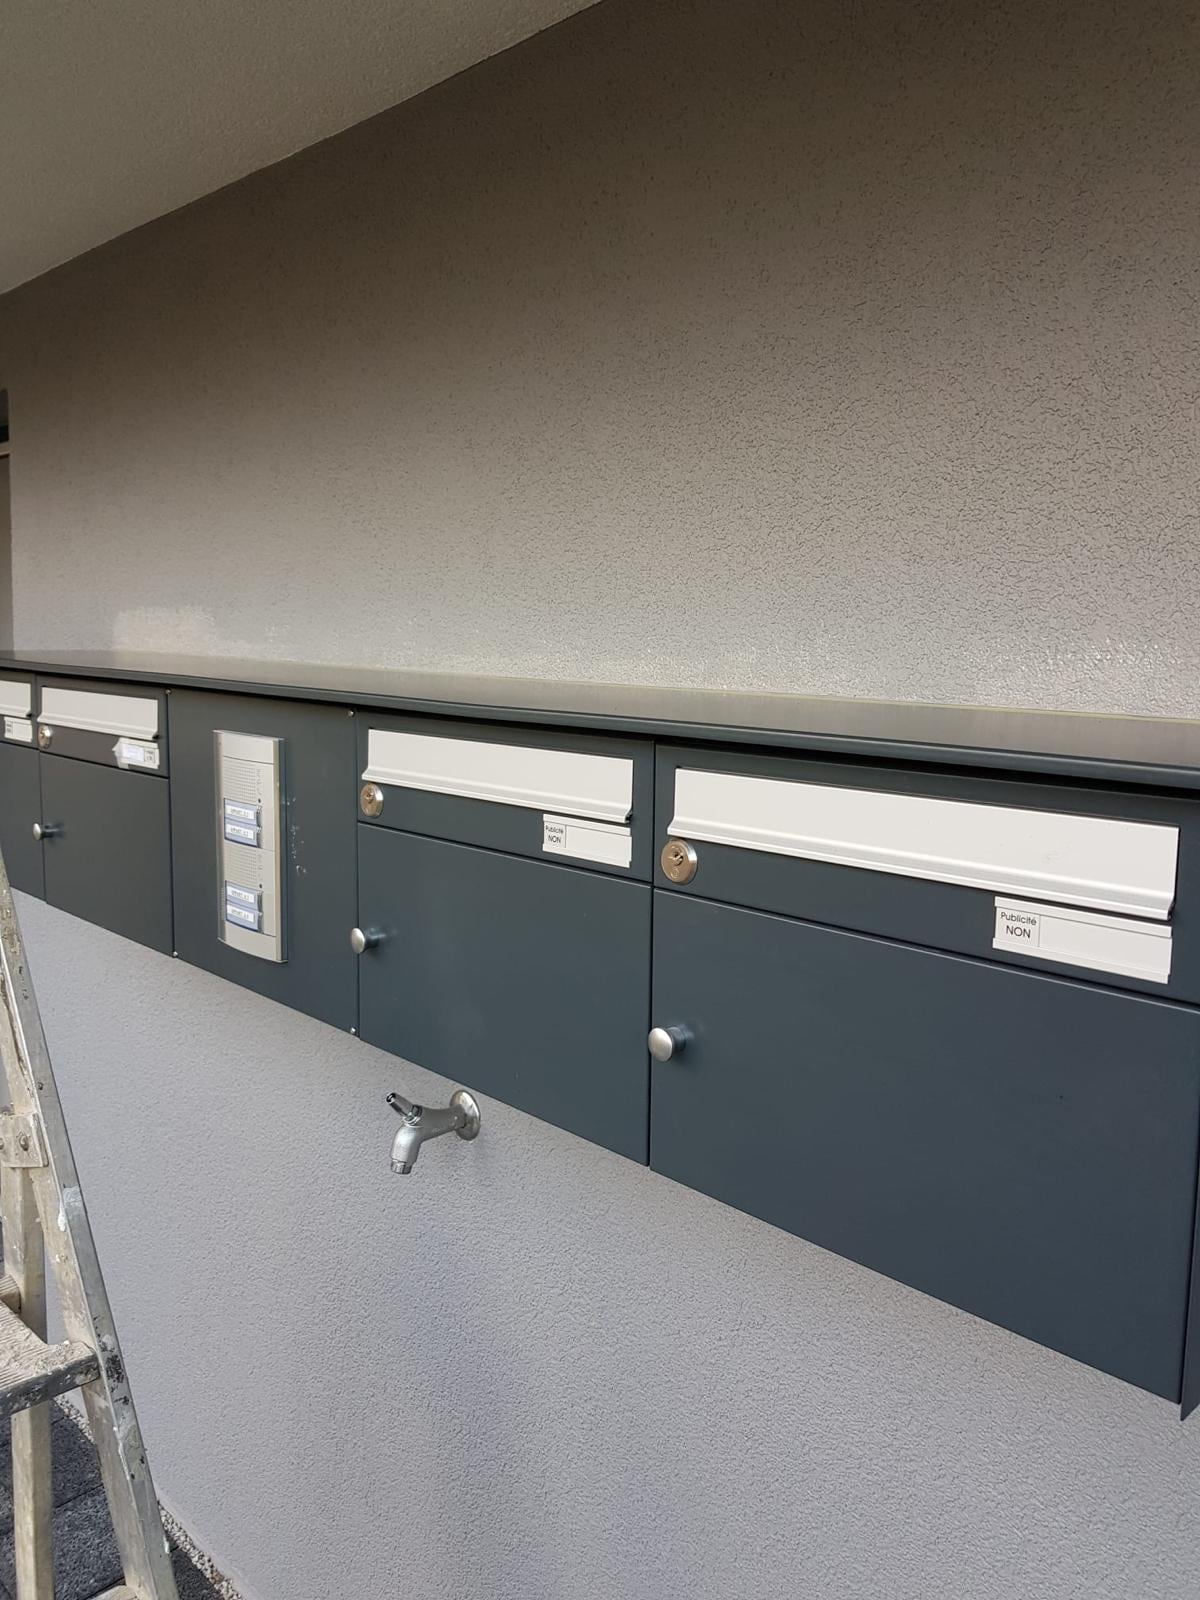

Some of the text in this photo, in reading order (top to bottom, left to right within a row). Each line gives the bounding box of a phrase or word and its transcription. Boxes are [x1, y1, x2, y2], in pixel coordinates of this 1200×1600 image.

[548, 834, 561, 844] NON
[1000, 911, 1037, 926] Publicité
[1006, 925, 1031, 939] NON
